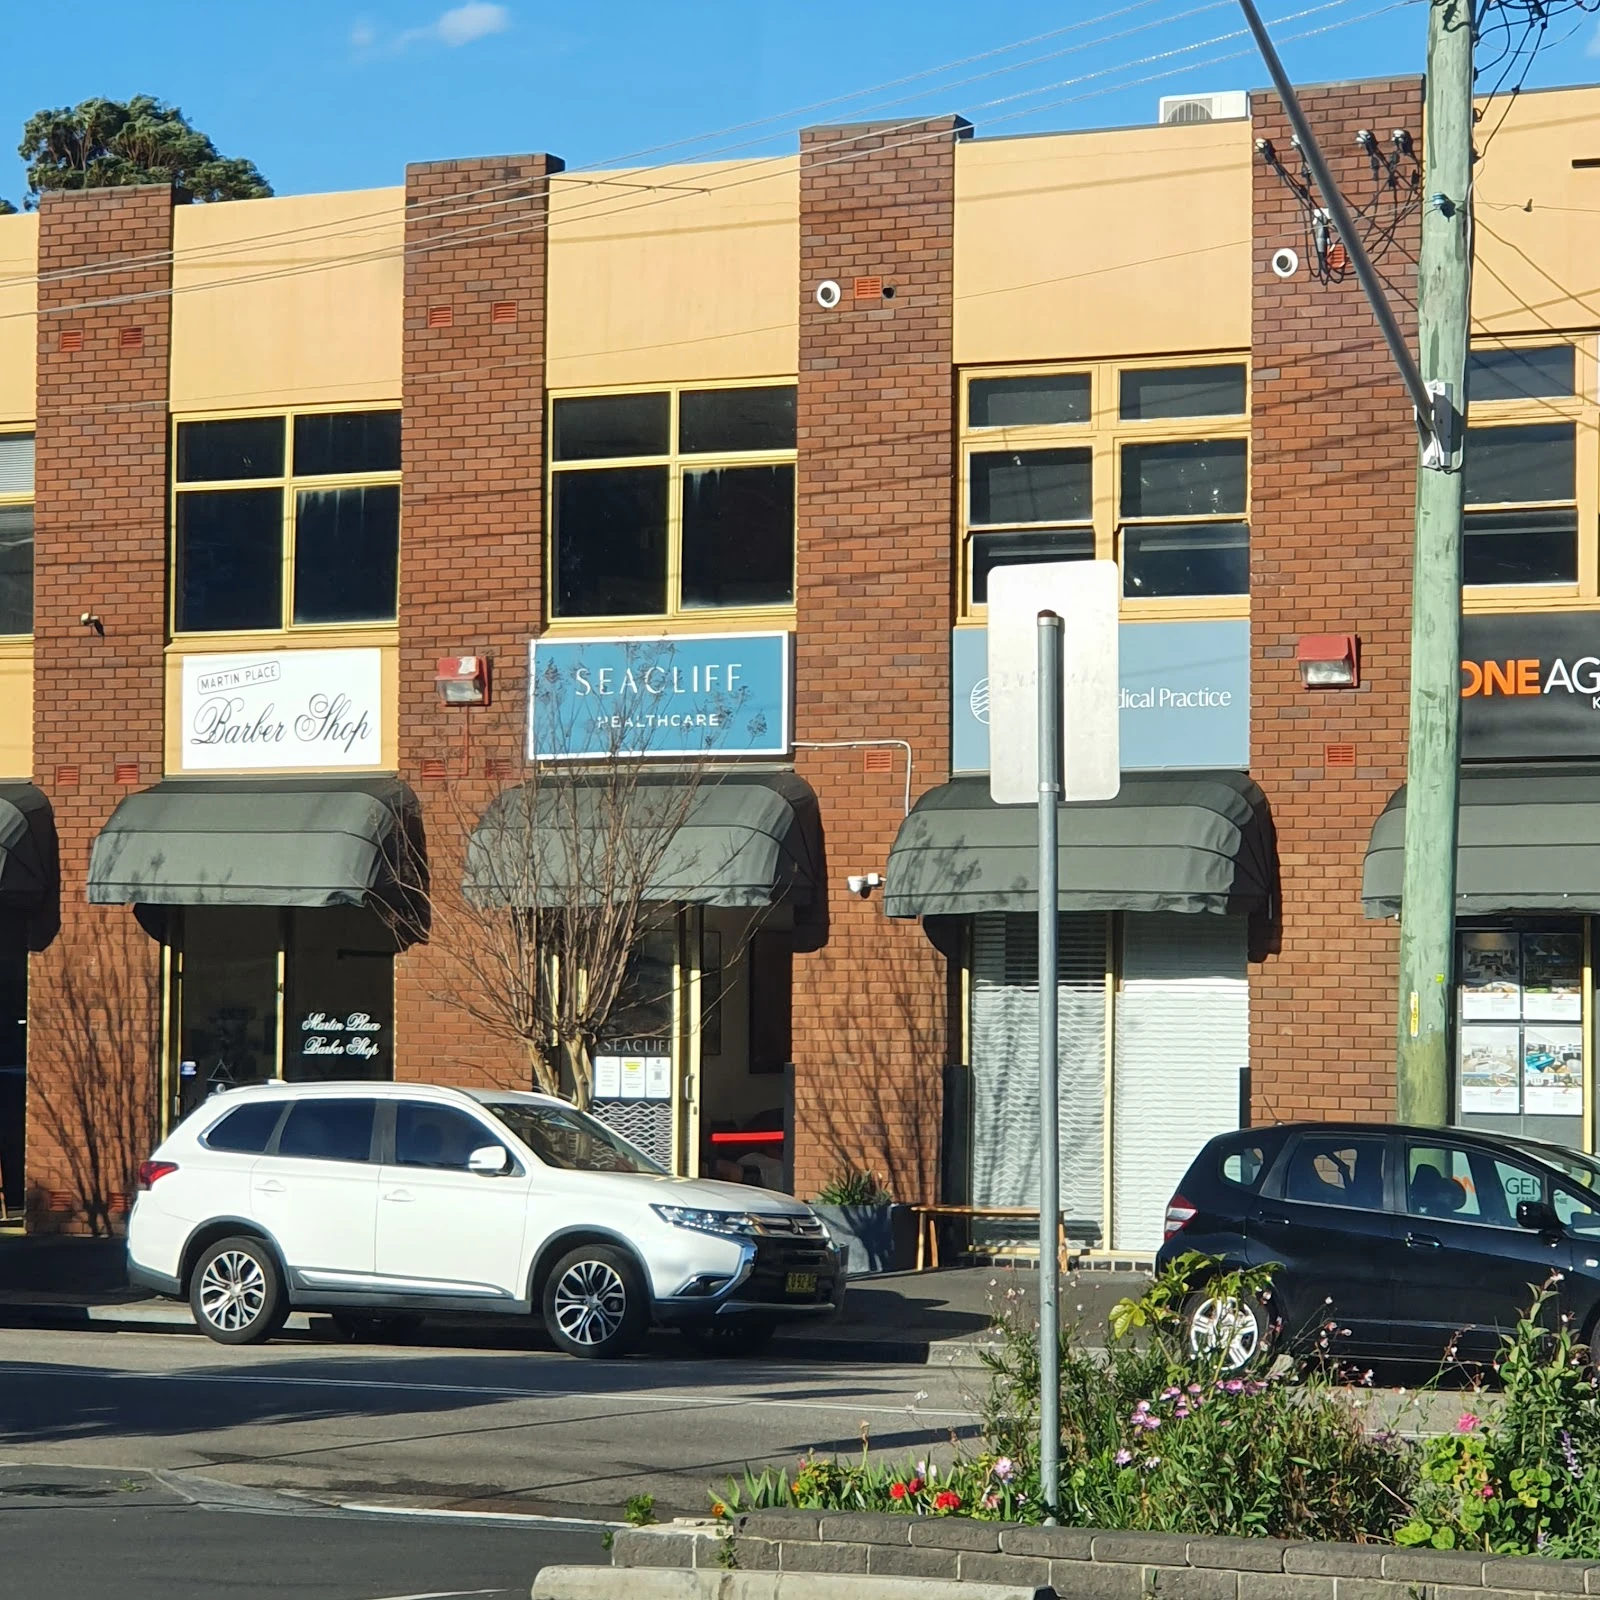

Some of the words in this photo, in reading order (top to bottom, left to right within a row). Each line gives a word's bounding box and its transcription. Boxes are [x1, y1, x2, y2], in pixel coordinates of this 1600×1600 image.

[200, 671, 241, 690] MARTIN
[245, 664, 277, 683] PLACE
[575, 663, 743, 697] SEACLIFF
[1118, 687, 1155, 709] dical
[1159, 686, 1232, 708] Practice
[190, 696, 288, 745] Barber
[294, 692, 373, 754] Shop
[597, 713, 720, 729] HEALTHCARE
[345, 1012, 382, 1031] Place
[303, 1036, 345, 1055] Barber
[345, 1036, 380, 1060] Shop
